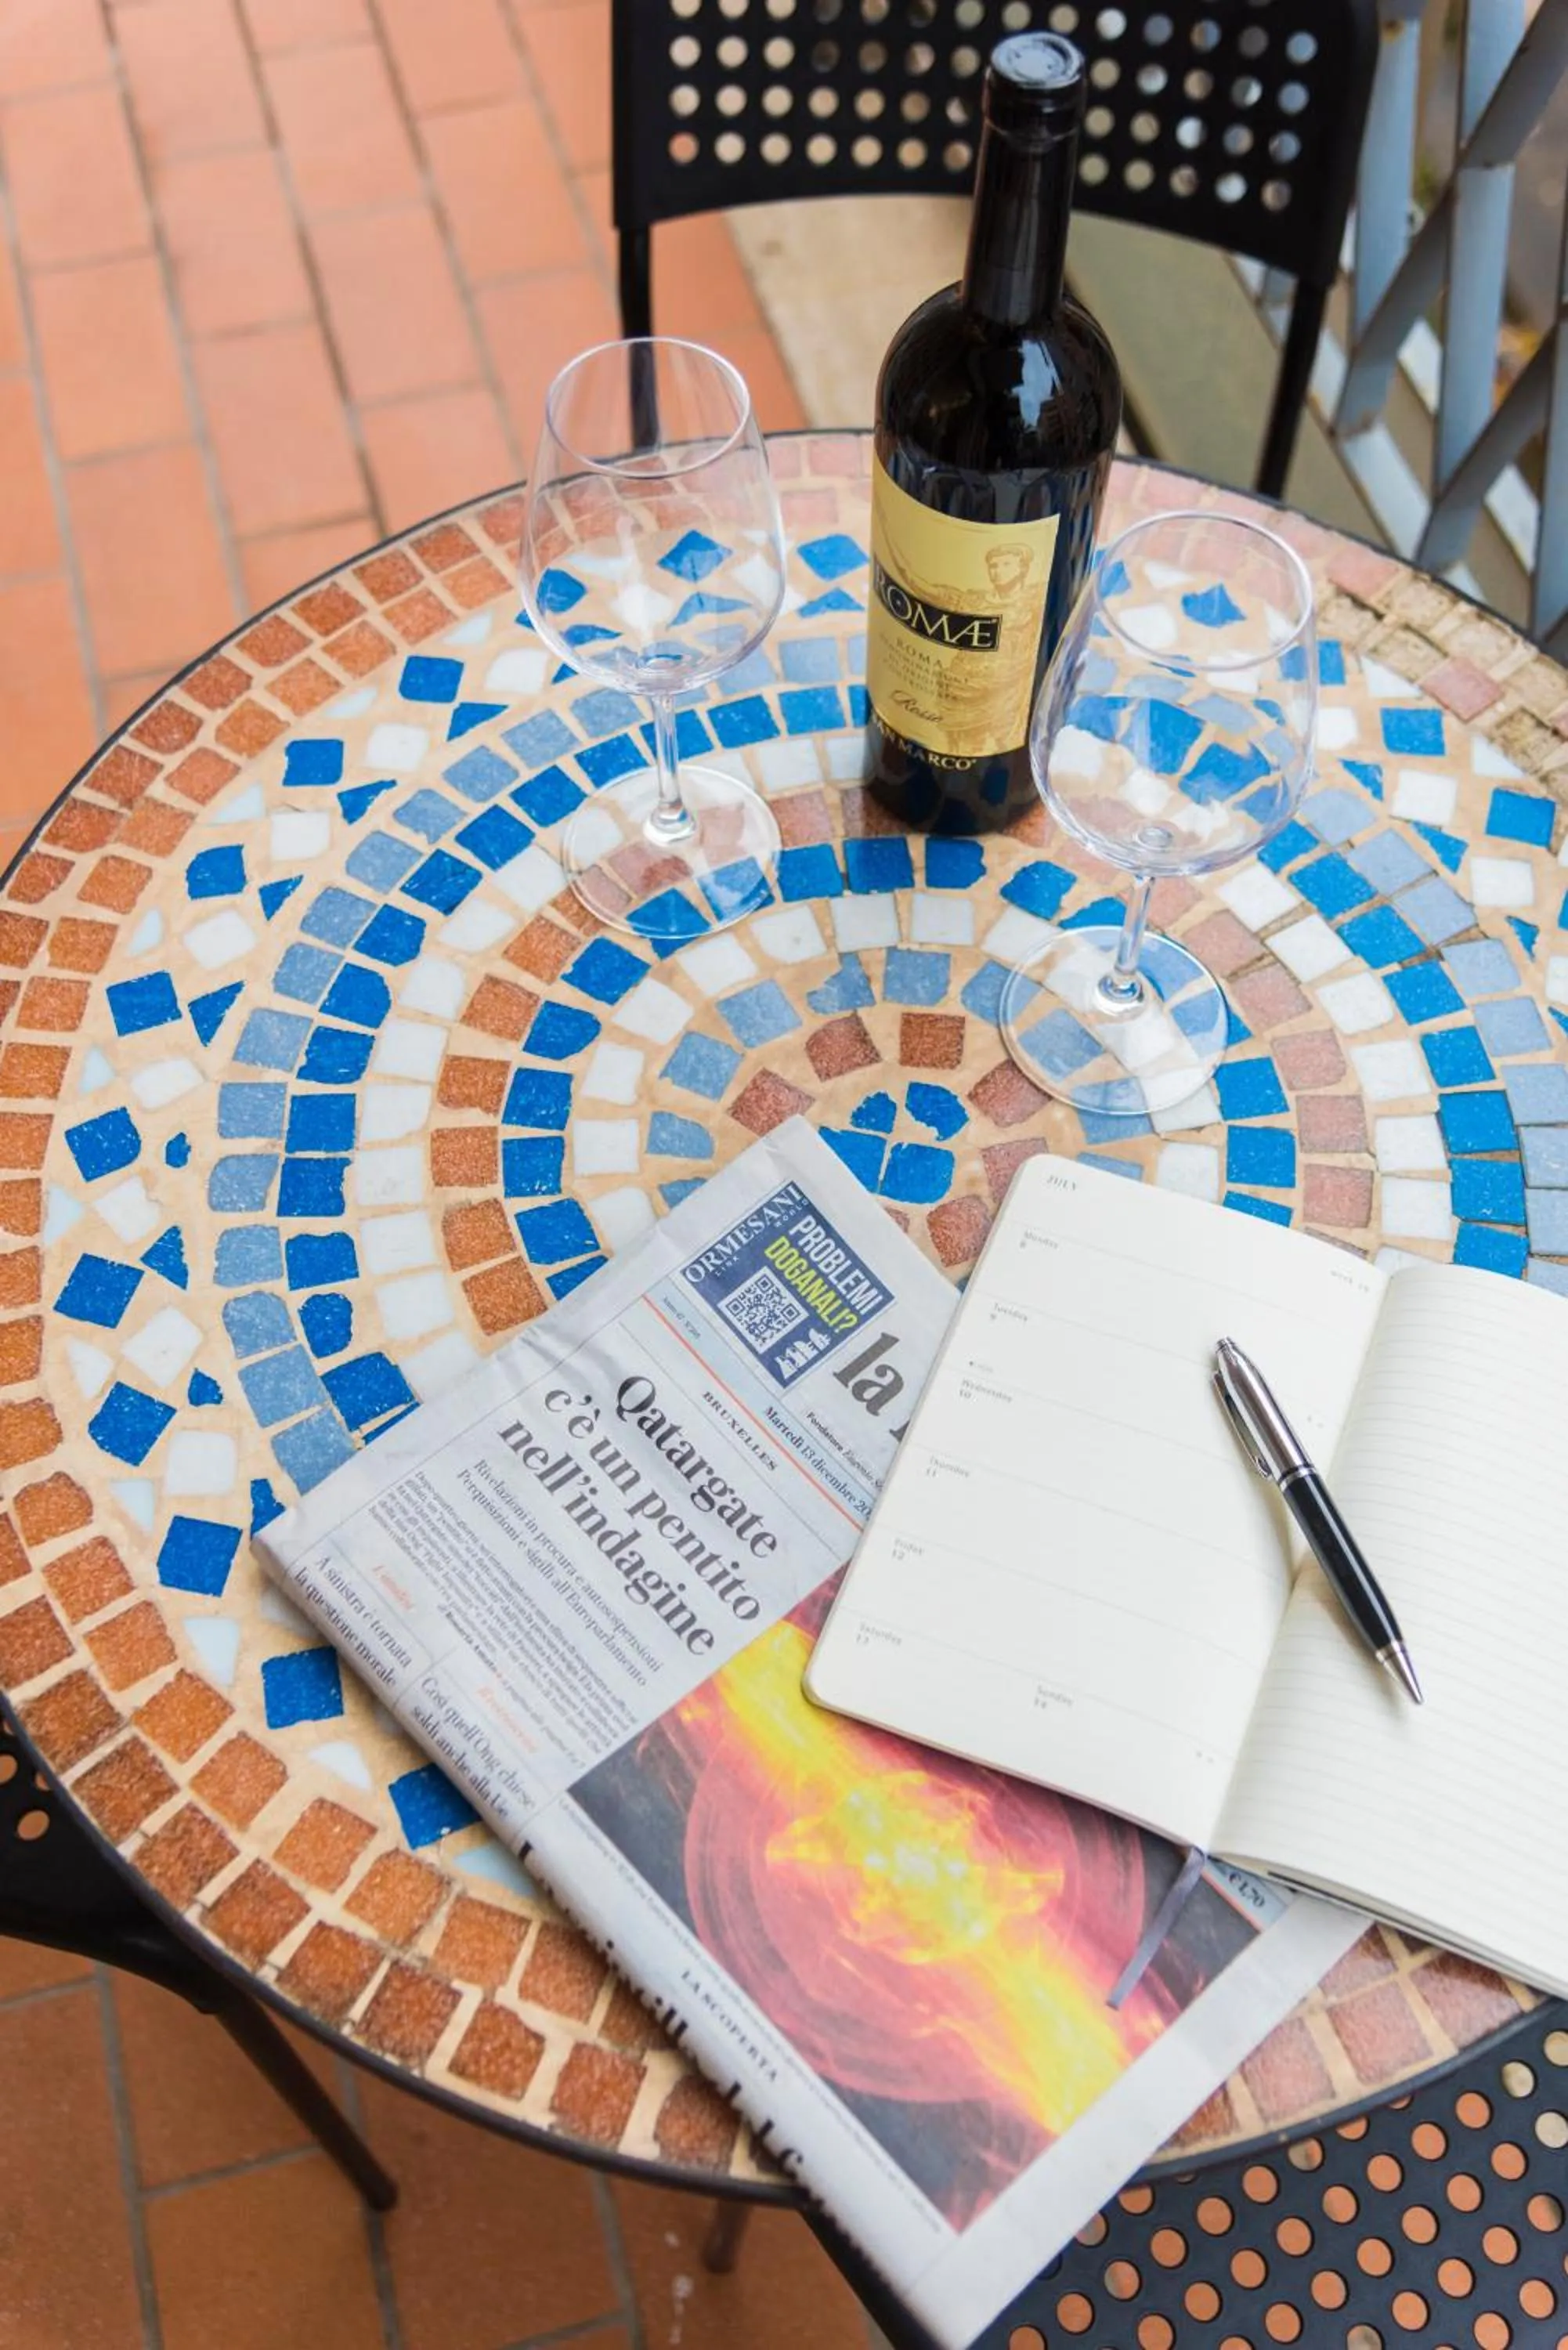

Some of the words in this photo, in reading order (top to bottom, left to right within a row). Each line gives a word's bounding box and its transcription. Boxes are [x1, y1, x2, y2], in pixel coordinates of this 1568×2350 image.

[685, 1185, 804, 1283] ORMESANI
[789, 1215, 883, 1316] PROBLEMI
[764, 1235, 859, 1333] DOGANALI?
[833, 1332, 904, 1417] la
[616, 1376, 777, 1559] Qatargate
[703, 1390, 779, 1472] BRUXELLES
[765, 1406, 805, 1449] Martedì
[800, 1444, 816, 1460] 13
[811, 1458, 857, 1503] dicembre
[473, 1459, 528, 1521] Rivelazioni
[524, 1517, 539, 1535] in
[533, 1531, 577, 1577] procura
[580, 1582, 664, 1673] autosospensioni
[526, 1547, 555, 1580] sigilli
[589, 1437, 642, 1495] un
[625, 1489, 761, 1621] pentito
[289, 1566, 309, 1589] la
[299, 1583, 359, 1648] questione
[351, 1641, 396, 1691] morale
[323, 1567, 367, 1615] sinistra
[368, 1619, 412, 1669] tornata
[405, 1706, 440, 1741] soldi
[430, 1737, 471, 1780] anche
[465, 1773, 491, 1802] alla
[495, 1768, 536, 1810] chiese
